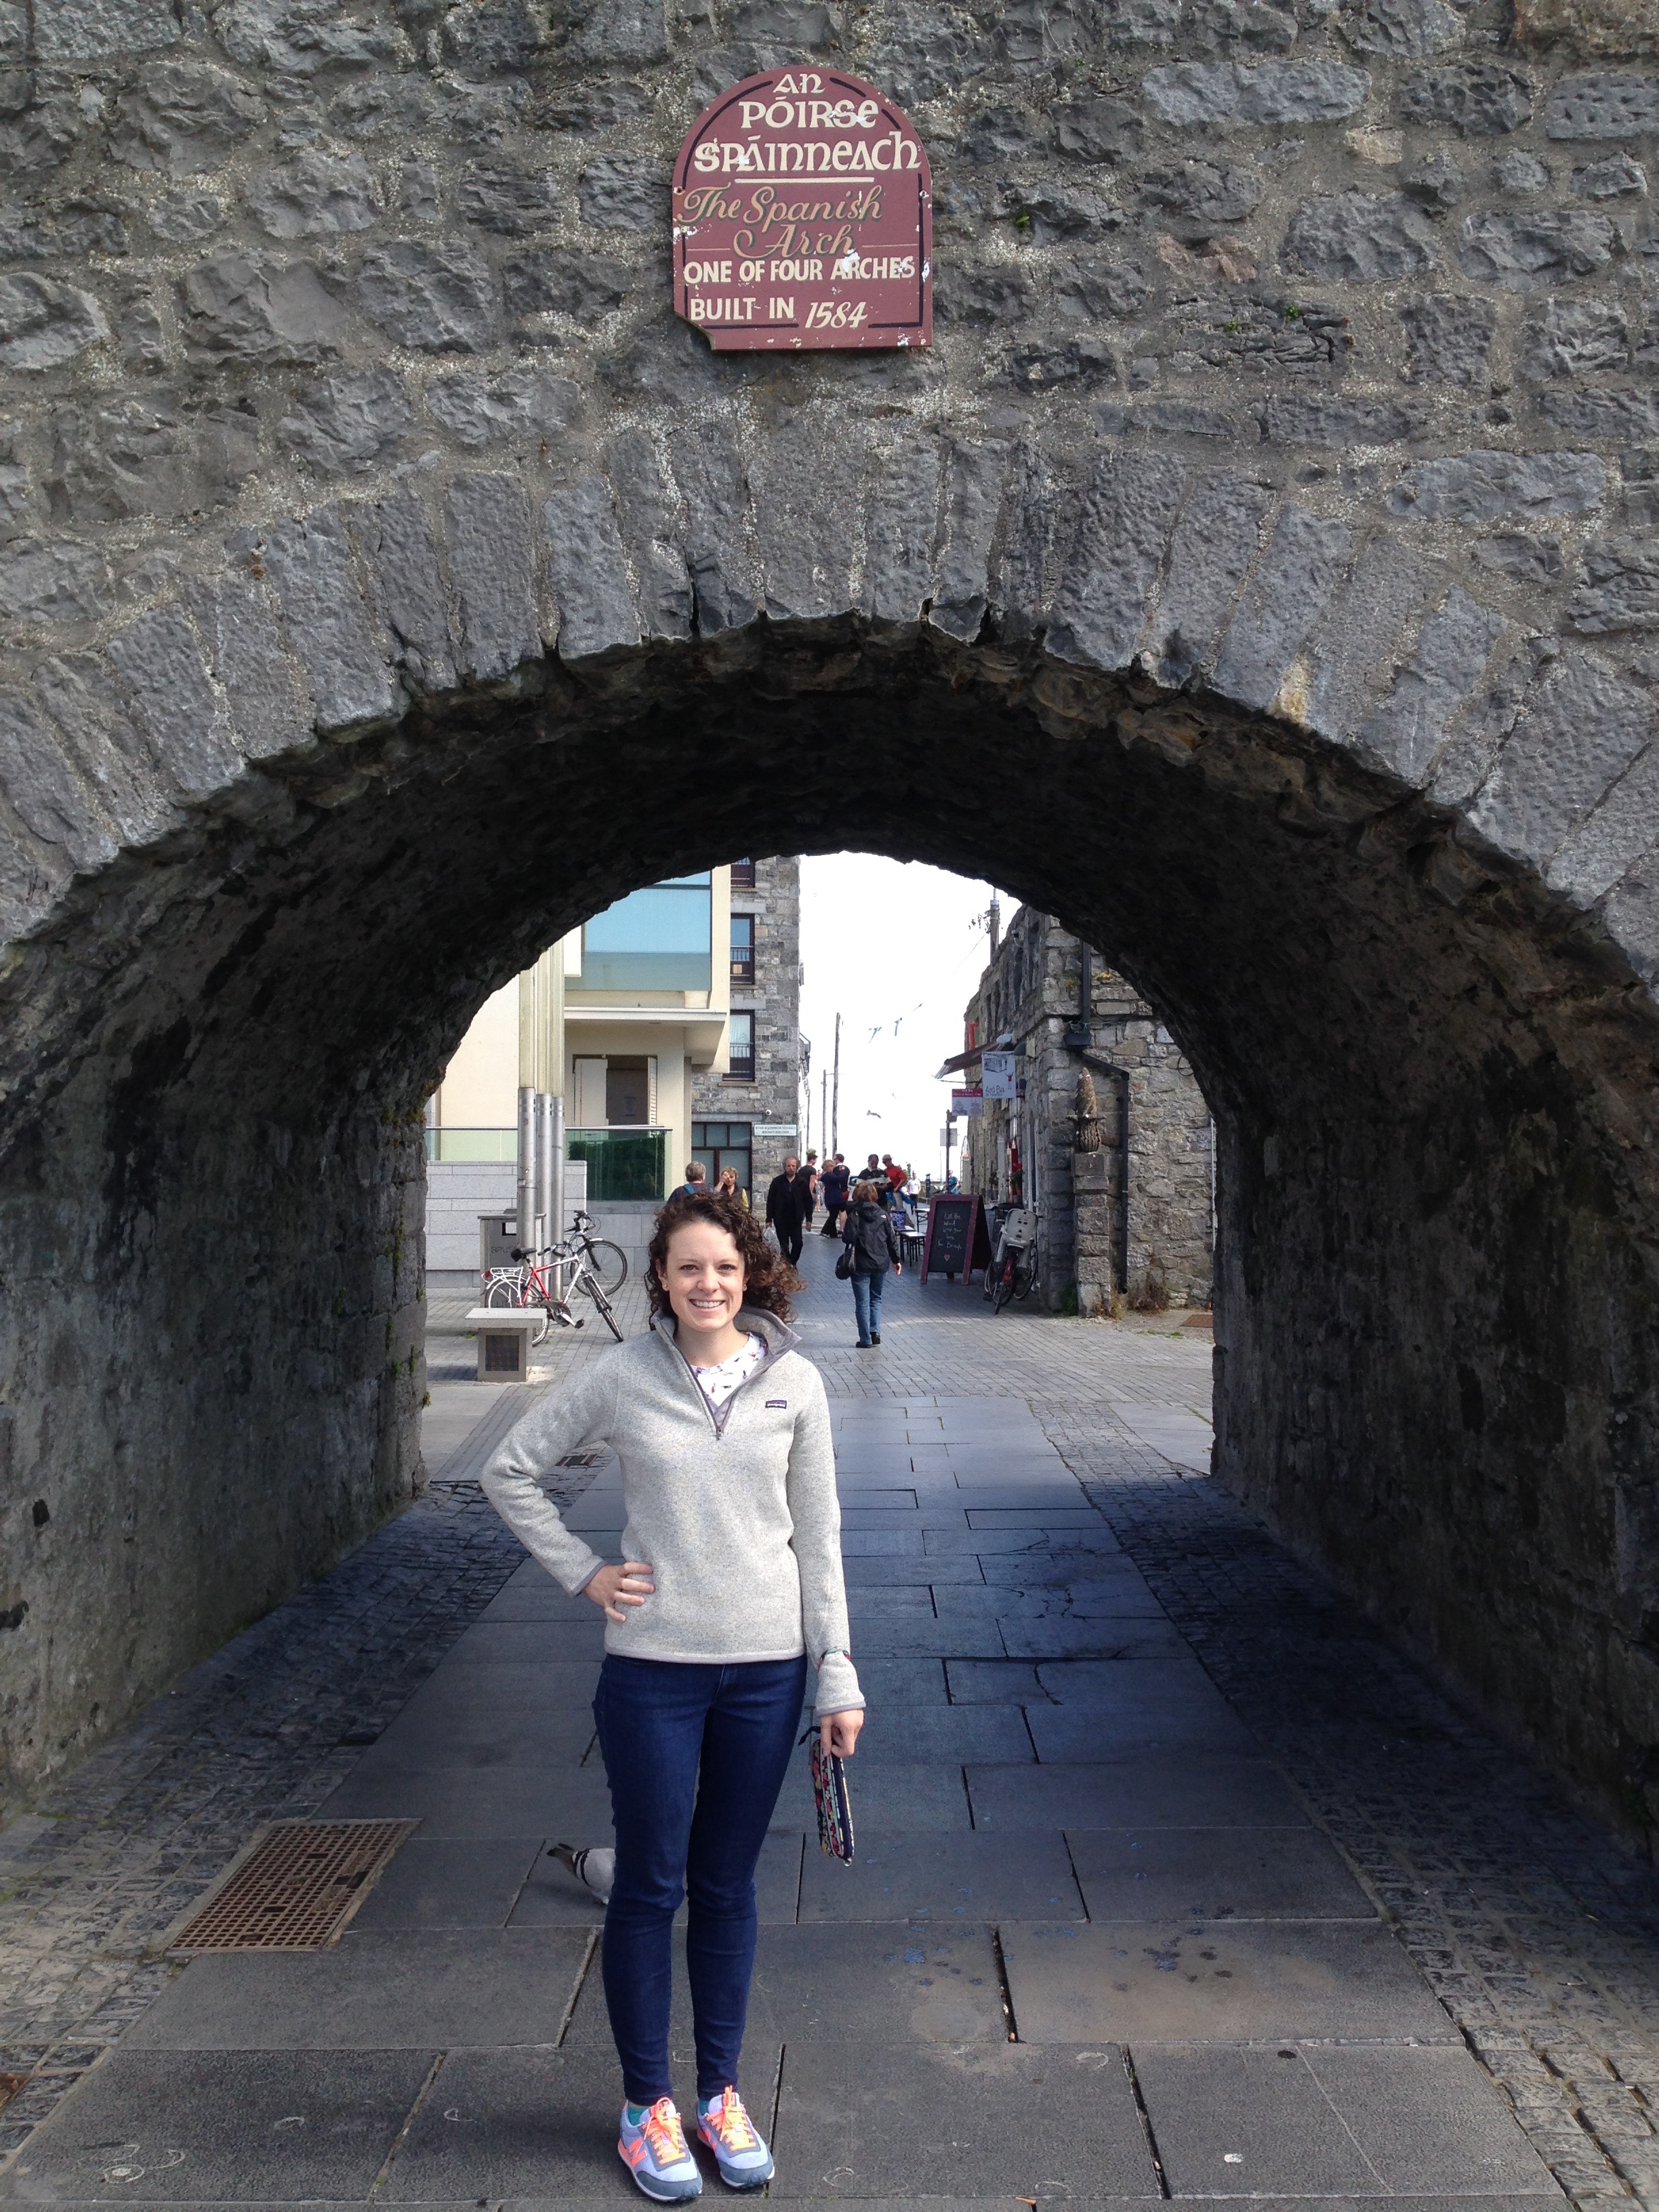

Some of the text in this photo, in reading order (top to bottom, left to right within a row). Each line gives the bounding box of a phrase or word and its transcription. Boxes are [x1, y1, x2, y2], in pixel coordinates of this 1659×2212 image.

[678, 182, 882, 234] The Spanish
[733, 224, 857, 259] Arch
[684, 256, 915, 283] ONE OF FOUR ARCHES
[691, 297, 868, 329] BUILT IN 1584
